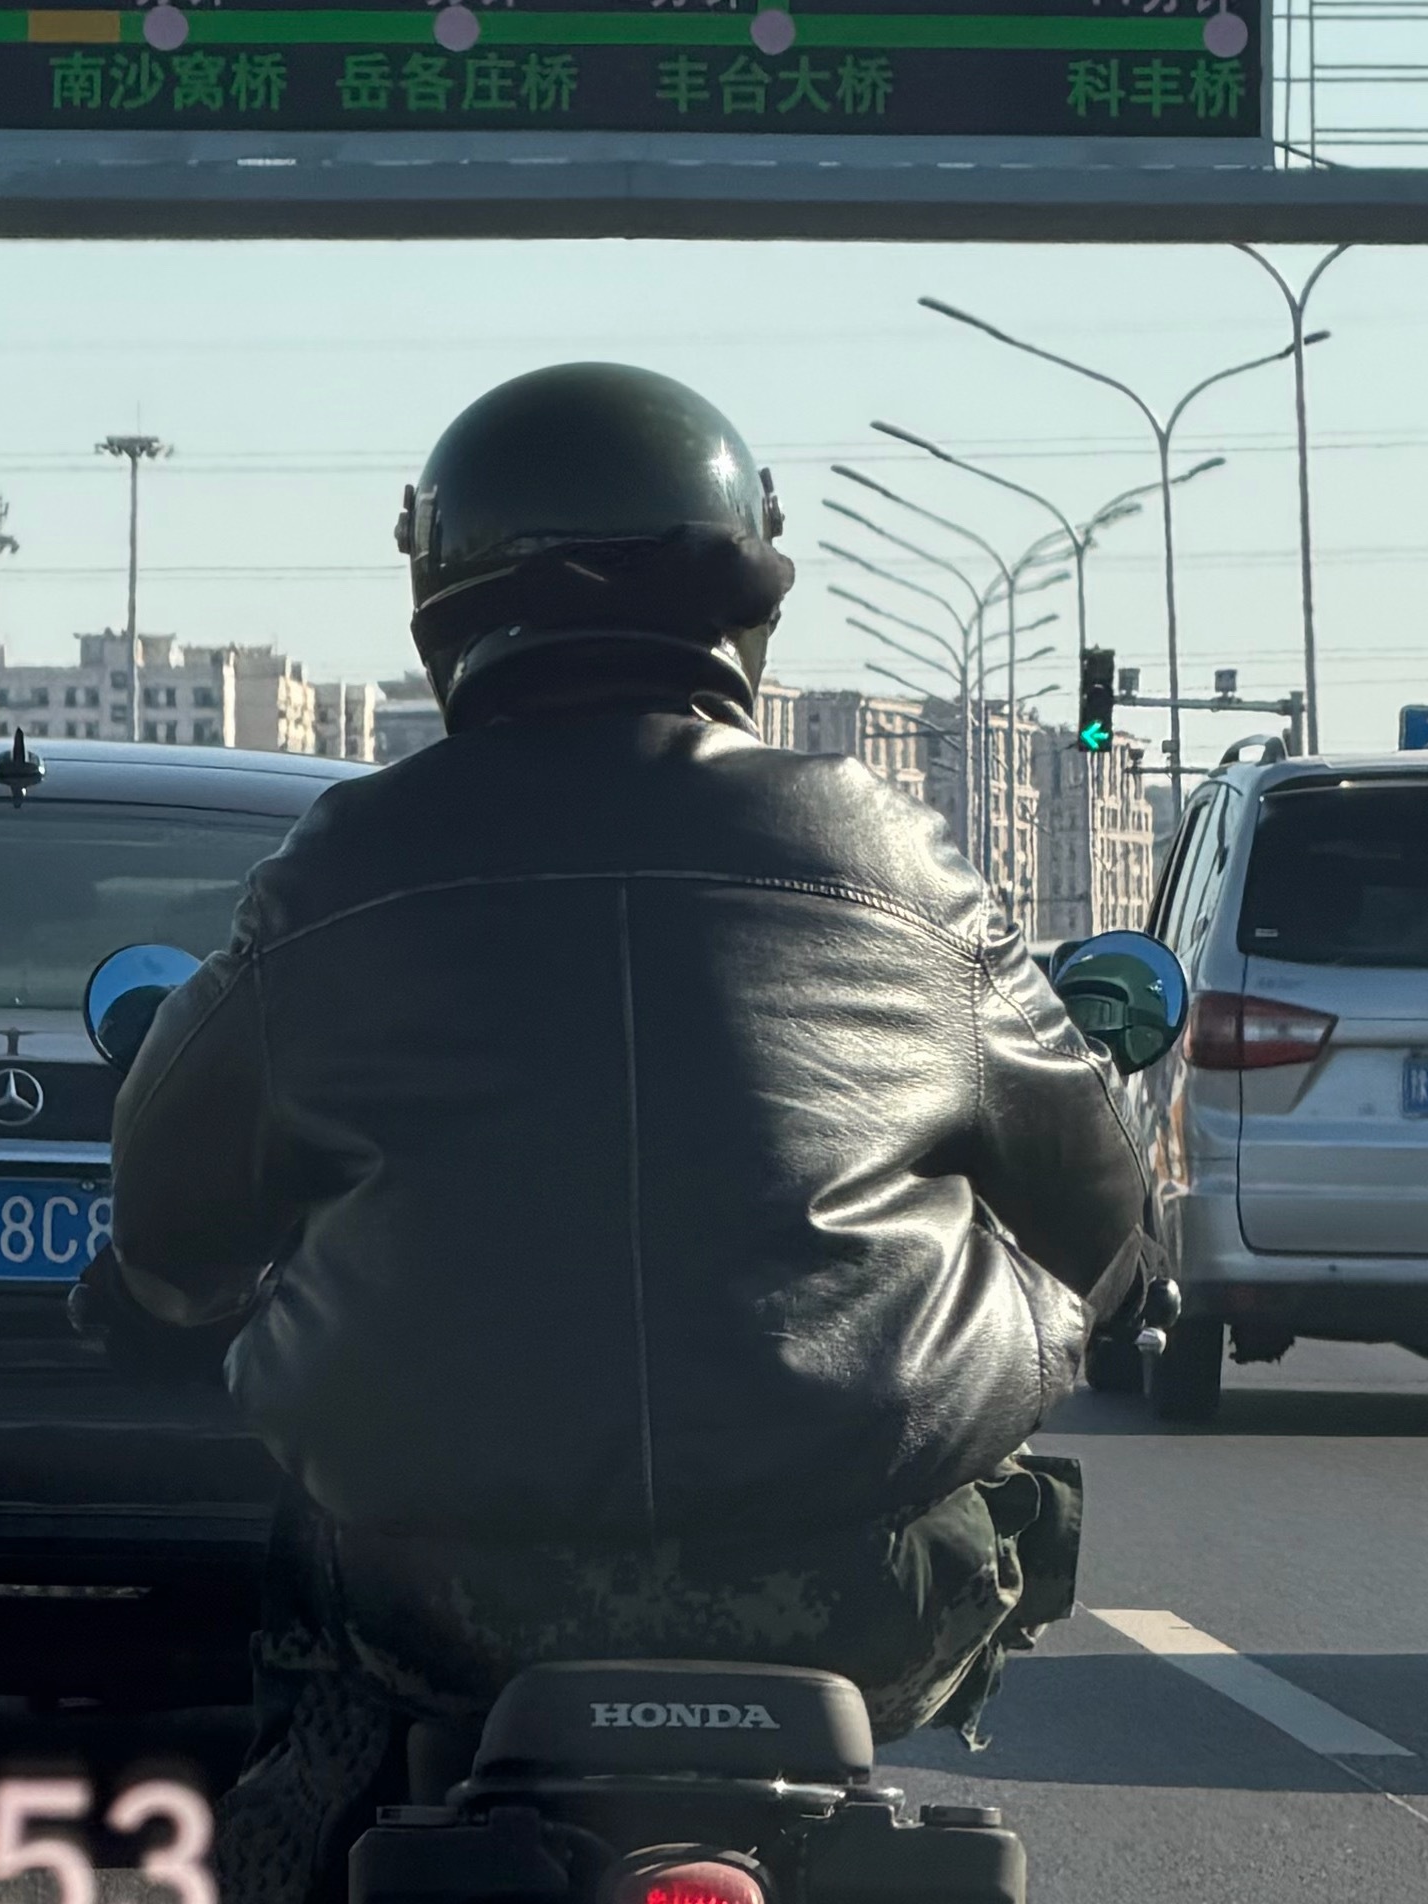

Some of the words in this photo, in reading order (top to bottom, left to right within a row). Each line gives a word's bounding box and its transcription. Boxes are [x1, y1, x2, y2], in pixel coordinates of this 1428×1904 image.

[49, 51, 289, 111] 南沙窝桥
[335, 52, 579, 112] 岳各庄桥
[655, 53, 895, 116] 丰台大桥
[1066, 58, 1247, 118] 科丰桥
[589, 1701, 781, 1730] HONDA
